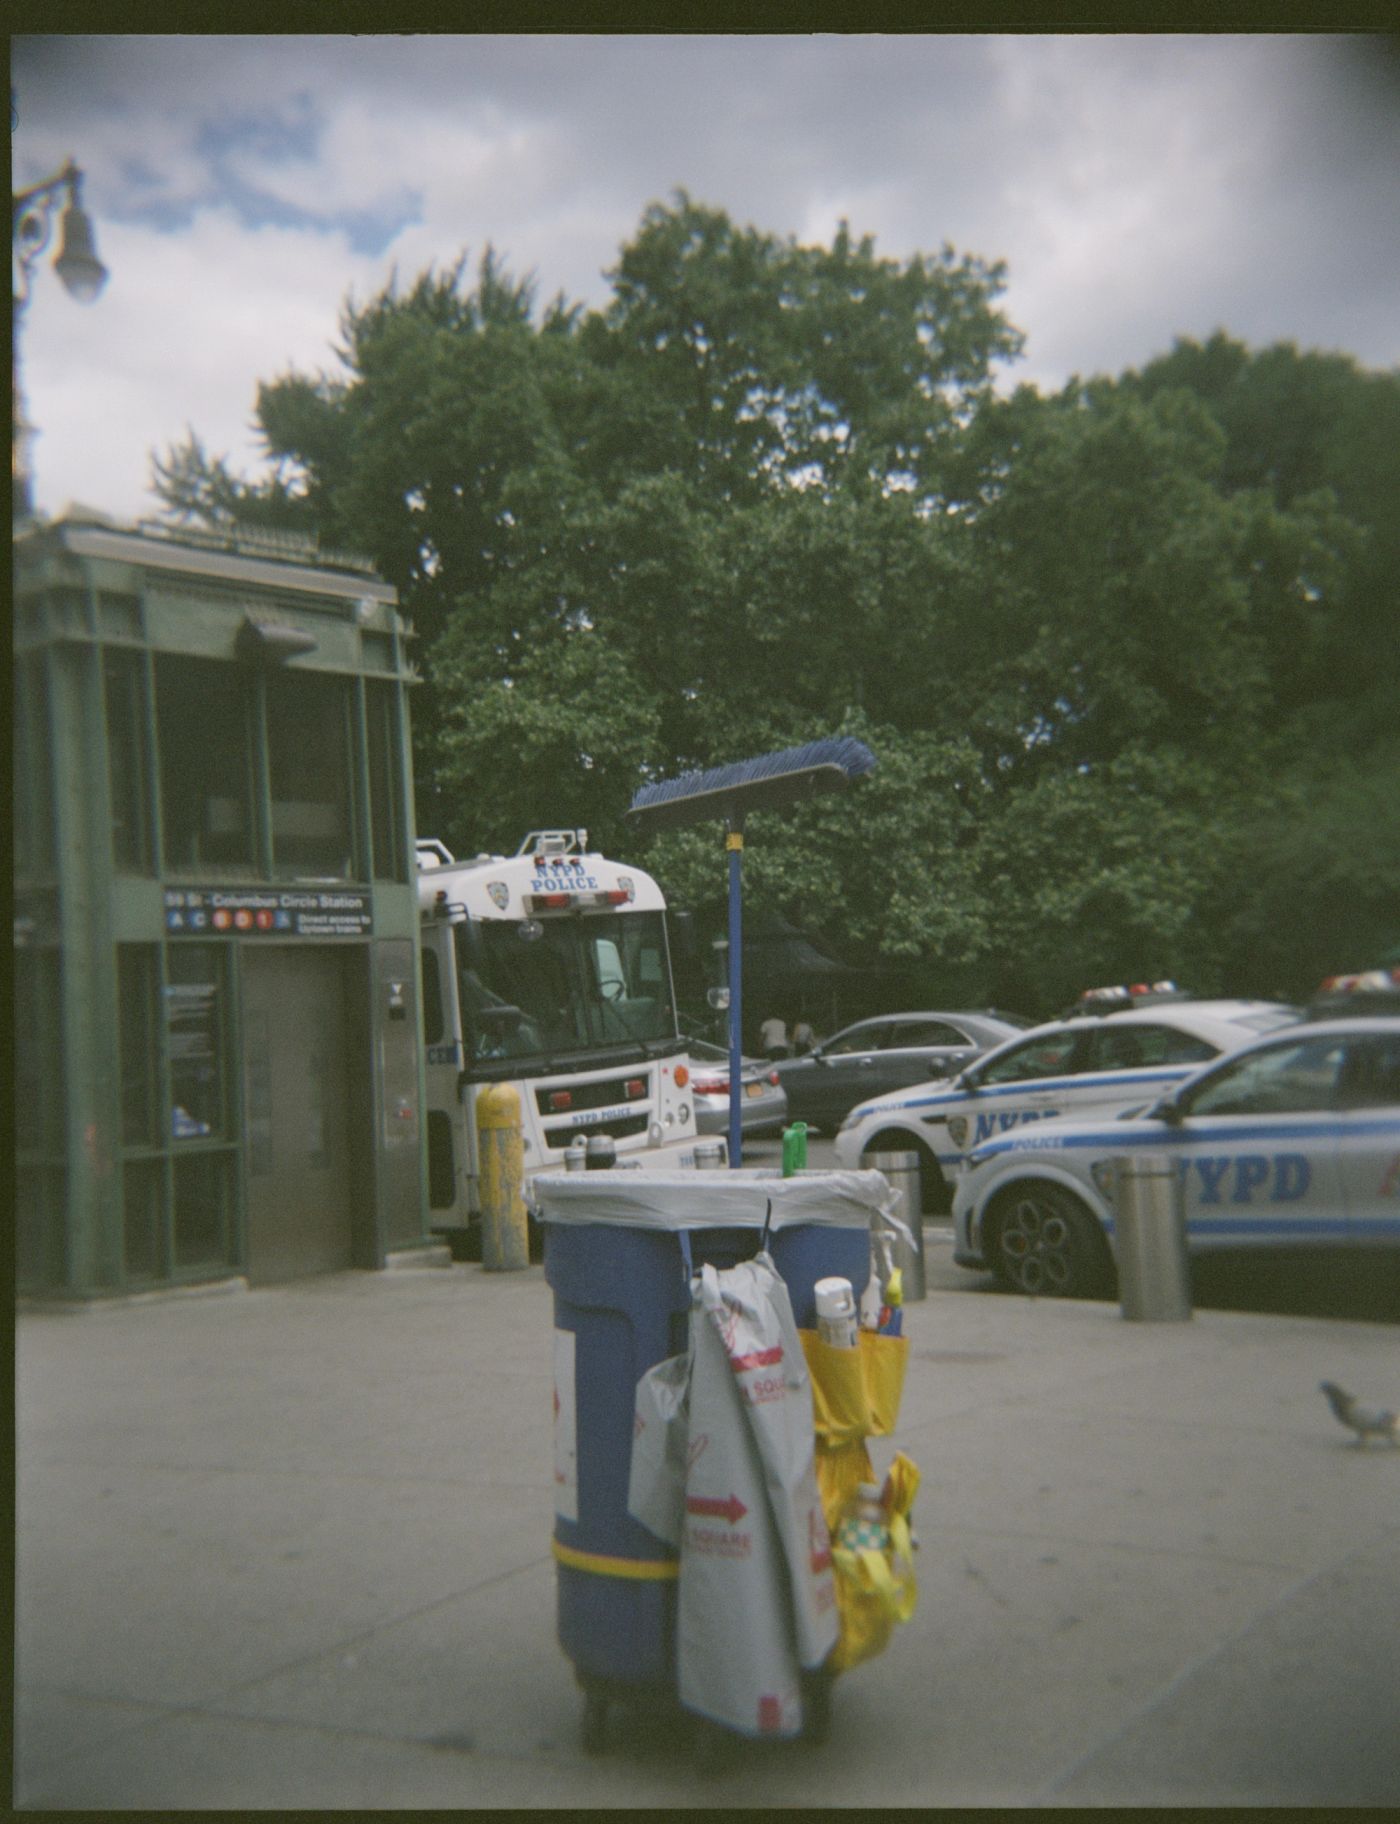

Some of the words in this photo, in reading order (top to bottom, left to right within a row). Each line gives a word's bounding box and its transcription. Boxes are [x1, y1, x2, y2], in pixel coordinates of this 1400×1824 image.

[535, 863, 586, 878] NYPD
[530, 877, 599, 892] POLICE
[212, 893, 278, 907] Columbus
[279, 894, 318, 908] Circle
[319, 894, 363, 908] Station
[571, 1112, 598, 1126] NYPD
[601, 1106, 631, 1120] POLICE
[973, 1110, 1061, 1147] NY
[1013, 1135, 1062, 1149] POLICE
